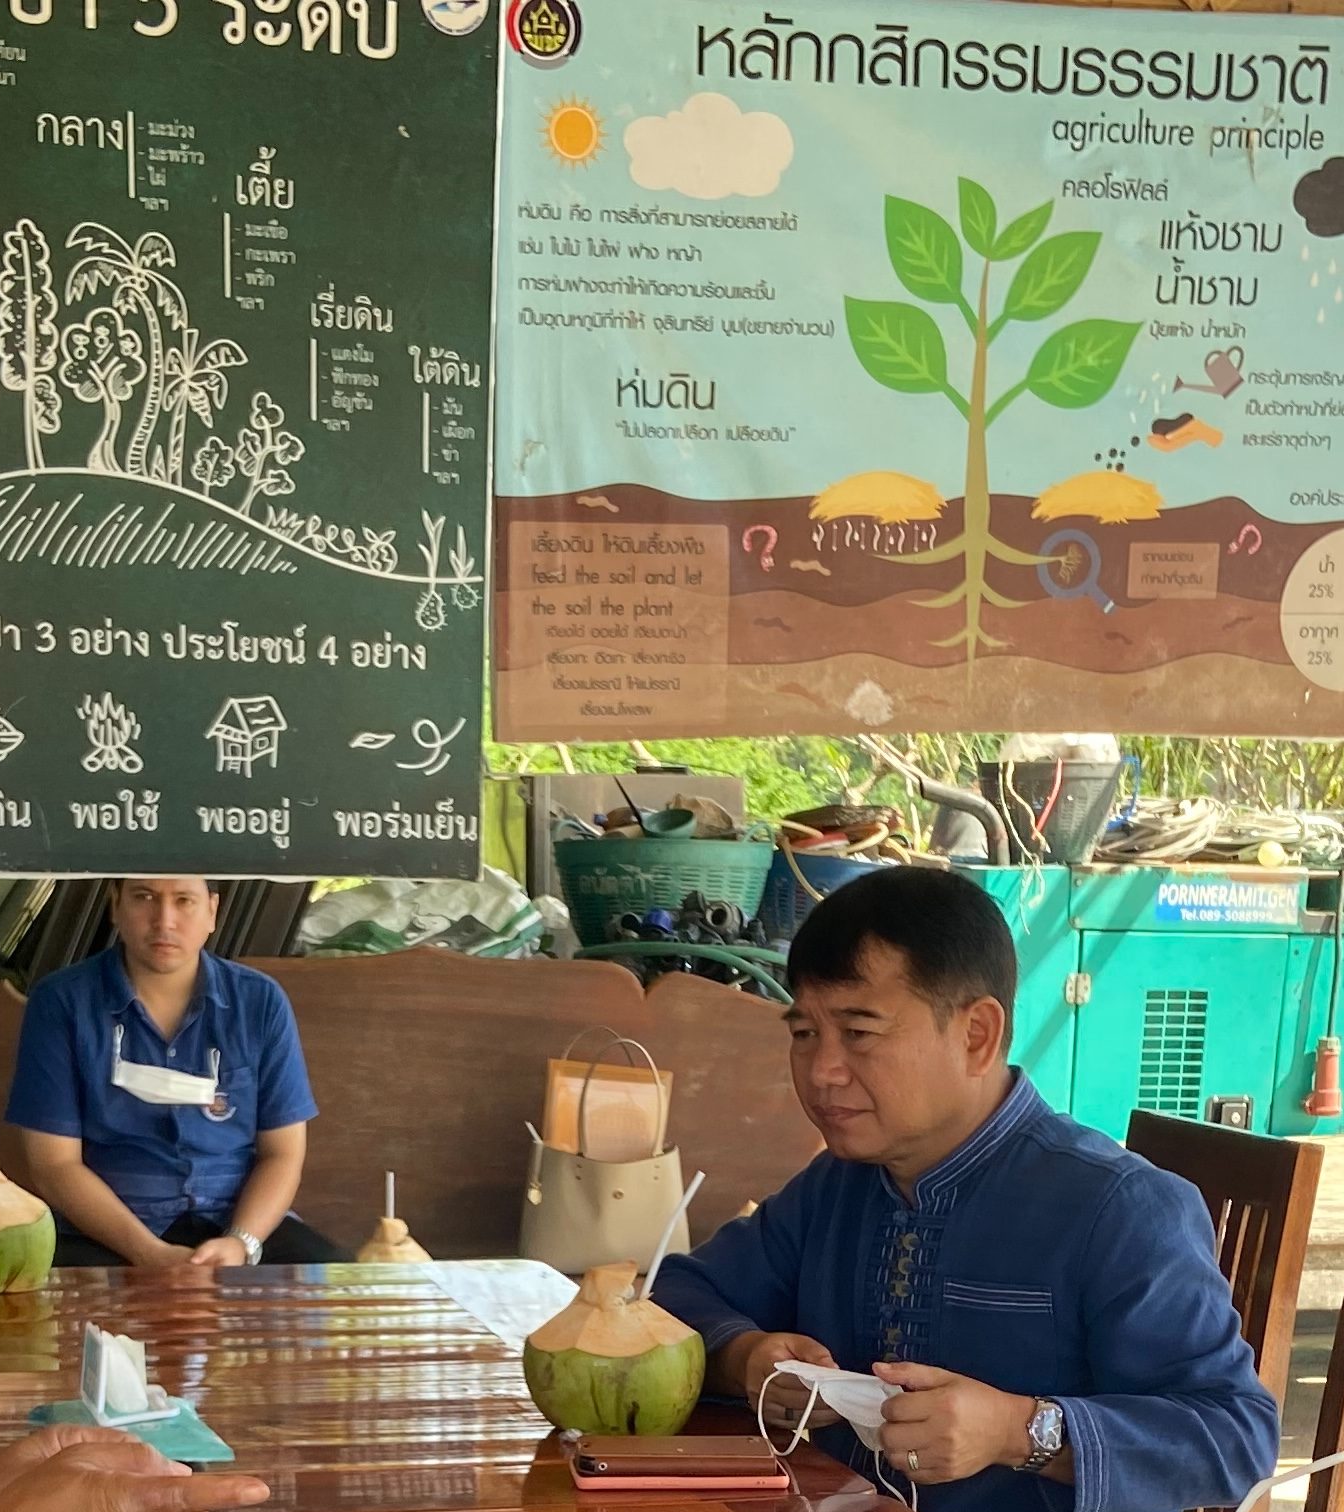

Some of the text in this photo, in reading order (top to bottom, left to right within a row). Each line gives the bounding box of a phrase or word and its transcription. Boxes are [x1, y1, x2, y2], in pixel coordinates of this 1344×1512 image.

[696, 13, 1330, 106] หลักกสิกรรมธรรมชาติ
[36, 113, 124, 150] กลาง
[1051, 108, 1325, 159] agriculture principle
[235, 146, 295, 210] เตี้ย
[1062, 173, 1168, 203] คลอโรฟิลล์
[569, 202, 592, 221] คือ
[1160, 210, 1283, 254] แห้งชาม
[667, 242, 702, 262] หญ้า
[1156, 256, 1259, 307] น้ำชาม
[310, 282, 394, 332] เรี่ยดิน
[408, 345, 481, 387] ใต้ดิน
[616, 368, 716, 410] ห่มดิน
[531, 564, 703, 586] feed the soil and let
[1318, 554, 1336, 573] น้ำ
[532, 596, 674, 621] the soil the plant
[1308, 583, 1335, 600] 25%
[34, 621, 57, 654] 3
[69, 617, 150, 658] อย่าง
[164, 621, 308, 665] ประโยชน์
[318, 636, 339, 667] 4
[351, 631, 428, 671] อย่าง
[1308, 651, 1333, 666] 25%
[70, 790, 161, 832] พอใช้
[197, 799, 291, 849] พออยู่
[334, 798, 478, 842] พอร่มเย็น
